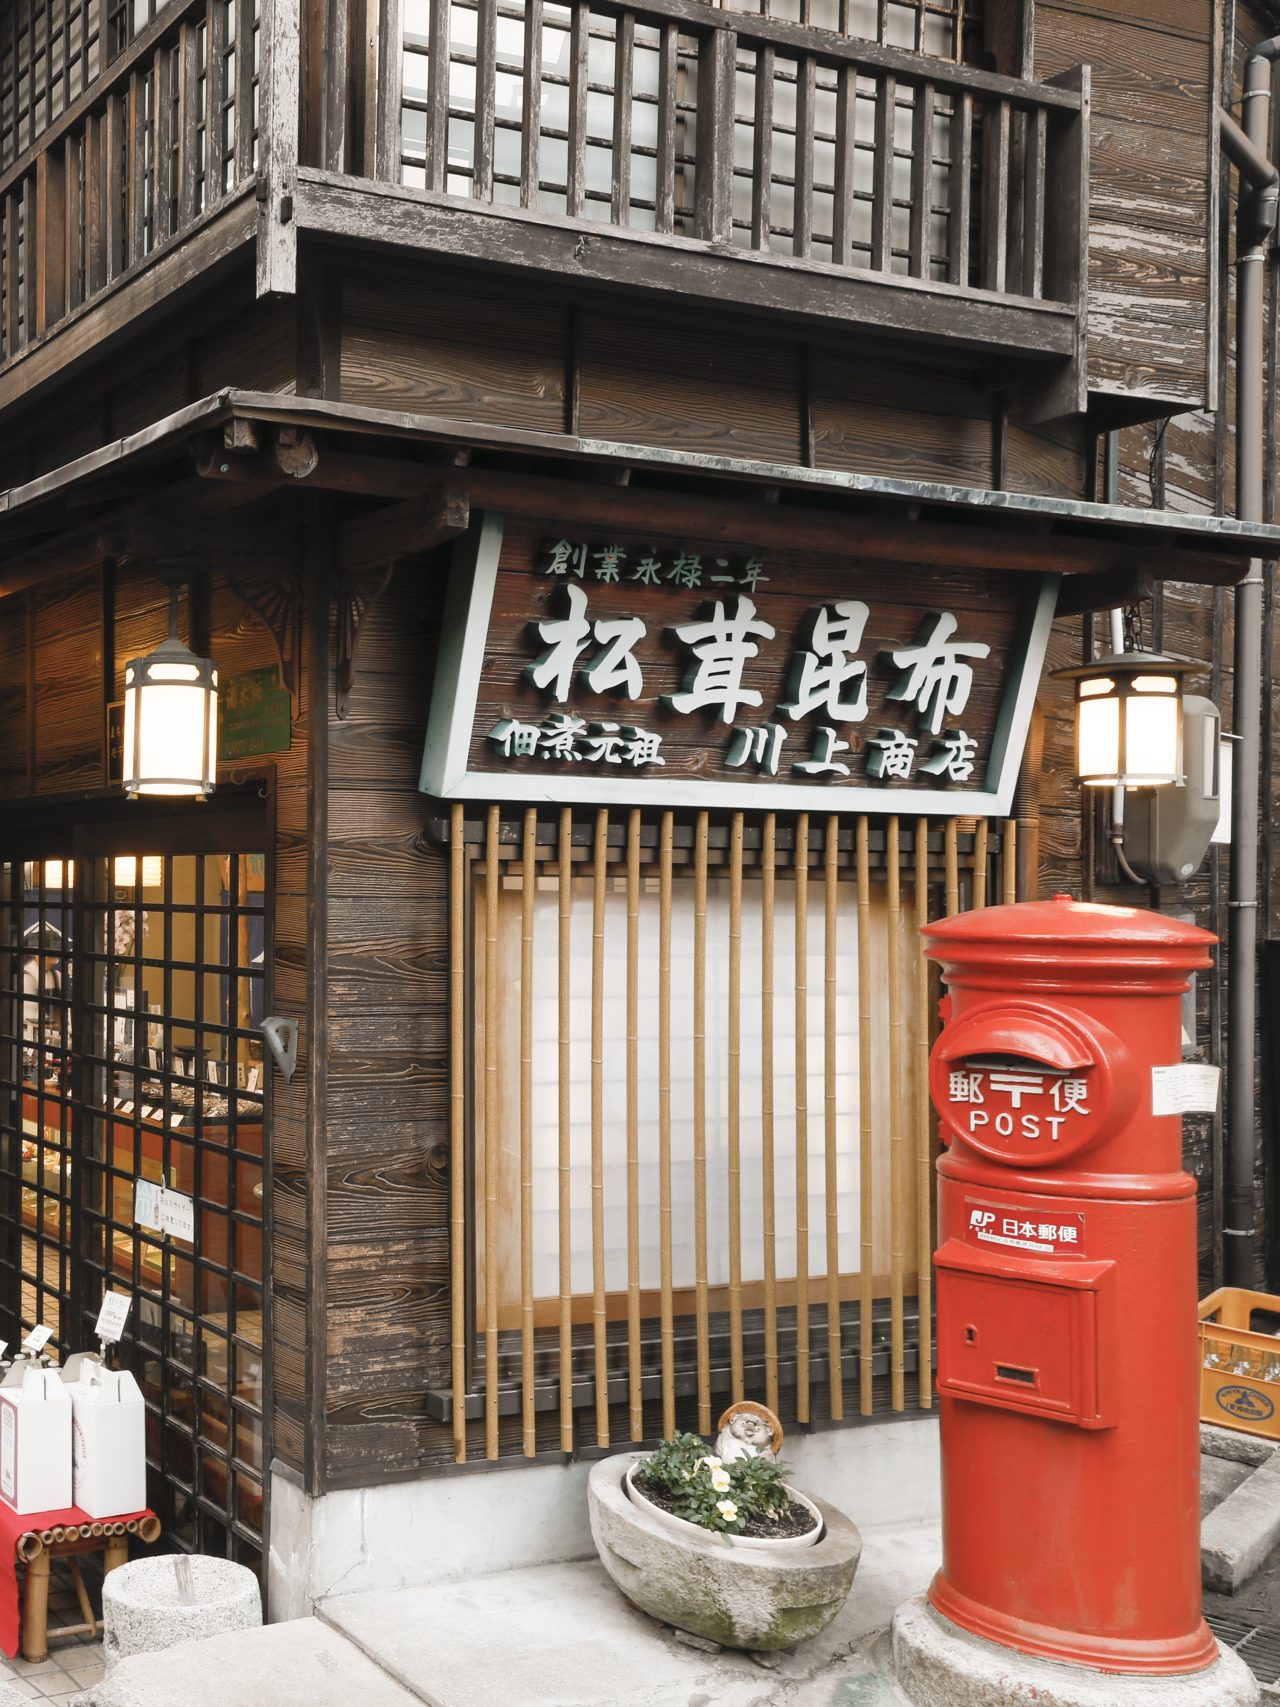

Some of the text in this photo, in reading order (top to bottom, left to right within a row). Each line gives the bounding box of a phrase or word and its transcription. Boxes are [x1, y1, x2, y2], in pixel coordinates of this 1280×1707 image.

[546, 539, 771, 594] 創業永禄二年
[528, 583, 991, 736] 松茸昆布
[492, 716, 667, 768] 佃煮元祖
[728, 722, 978, 783] 川上商店
[969, 1110, 1066, 1141] POST
[969, 1226, 994, 1235] POST
[1002, 1218, 1078, 1243] 日本郵便
